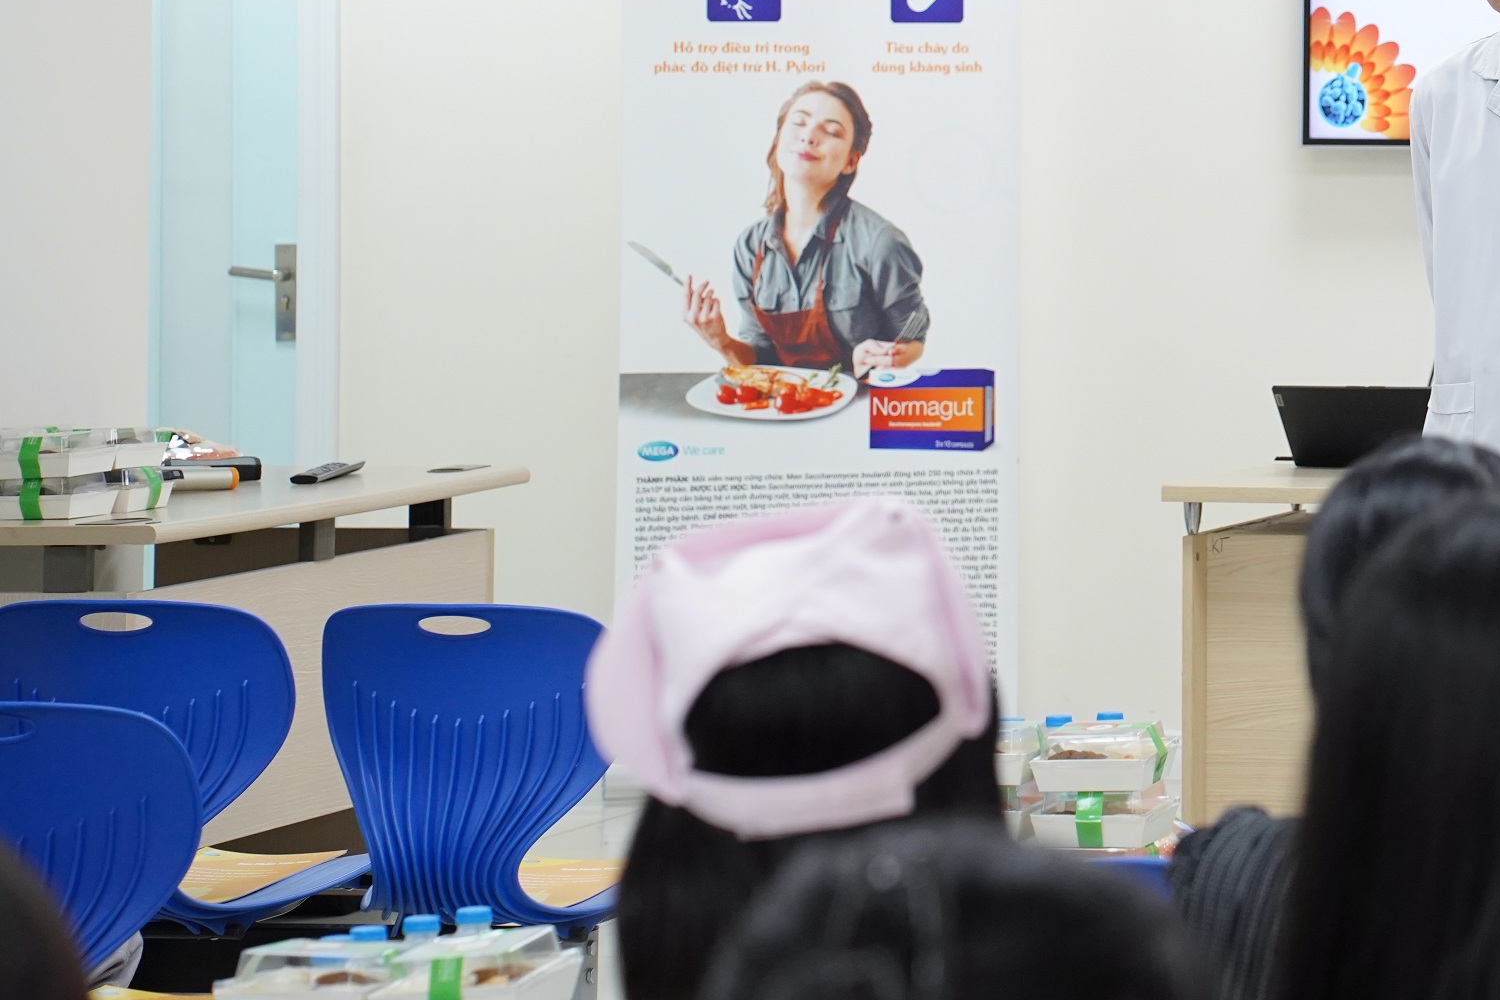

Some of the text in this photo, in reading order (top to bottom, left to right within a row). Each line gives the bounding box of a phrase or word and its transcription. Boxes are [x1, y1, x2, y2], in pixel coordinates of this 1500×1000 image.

[774, 43, 810, 56] trong
[952, 42, 969, 53] do
[766, 61, 781, 72] H.
[786, 60, 826, 74] Pylori
[955, 61, 983, 73] sinh
[872, 396, 975, 421] Normagut
[641, 445, 675, 457] MEGA
